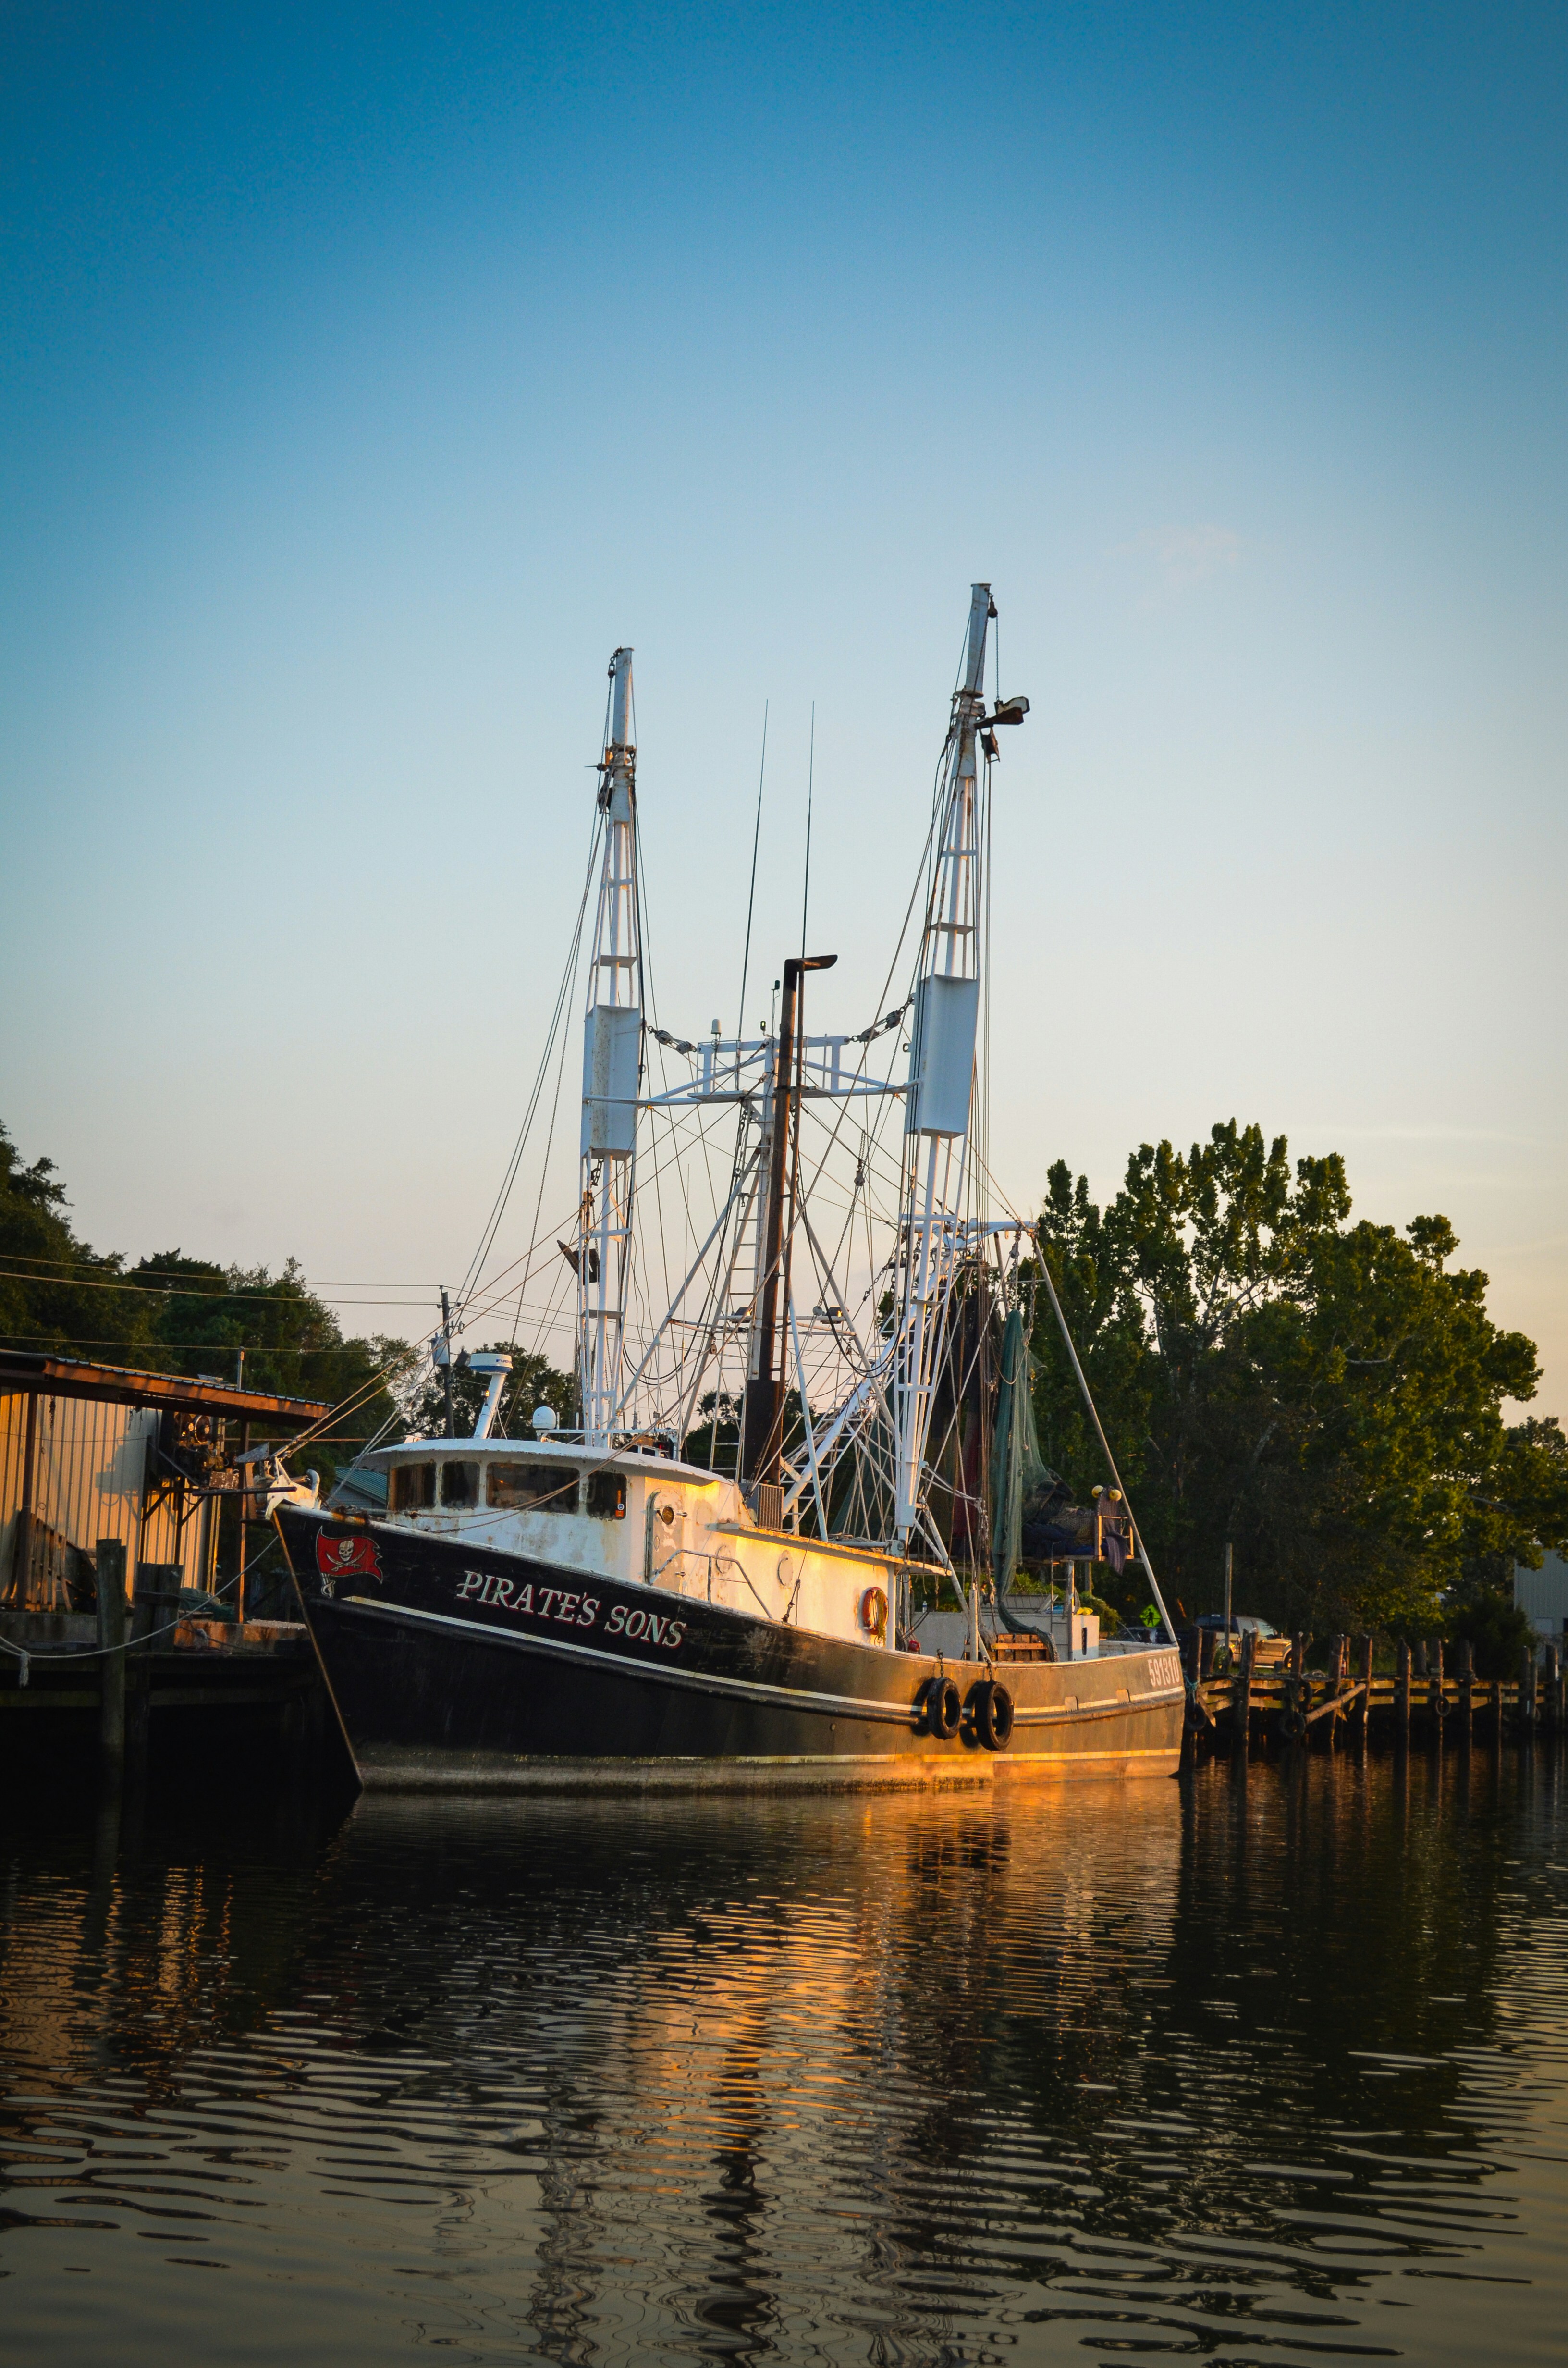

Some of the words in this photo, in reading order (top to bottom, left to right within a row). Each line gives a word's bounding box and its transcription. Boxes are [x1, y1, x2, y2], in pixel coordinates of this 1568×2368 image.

[456, 1570, 601, 1627] PIRATE'S
[604, 1605, 687, 1649] SONS
[1148, 1656, 1180, 1687] 591310
